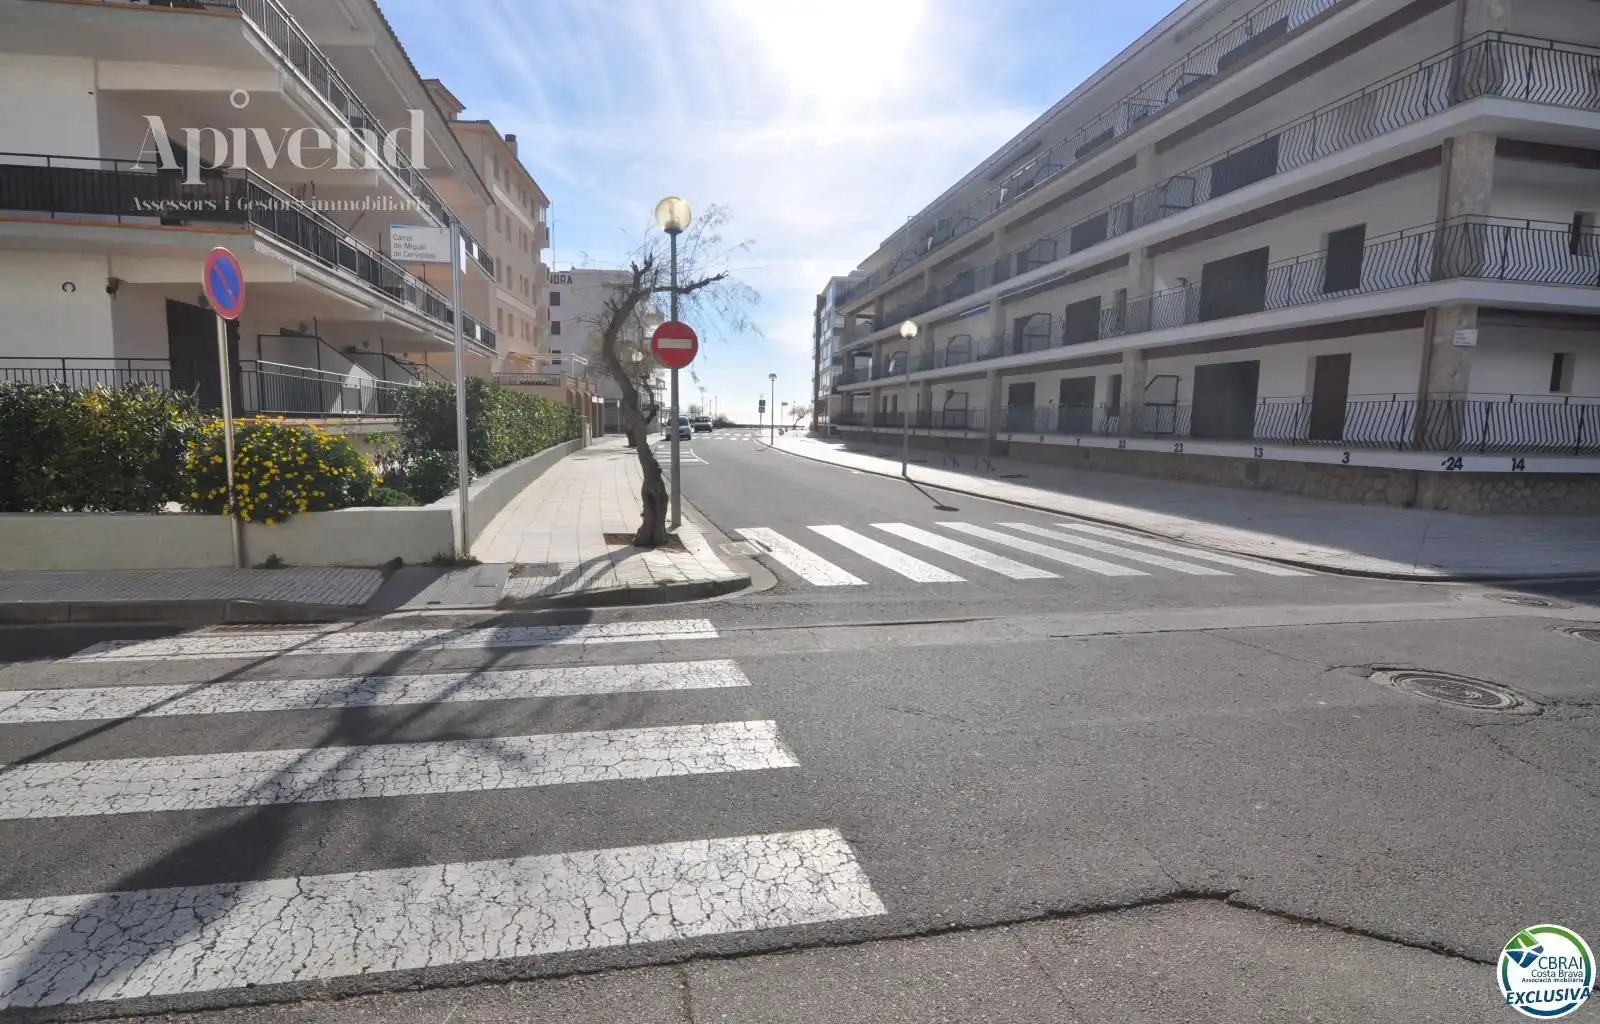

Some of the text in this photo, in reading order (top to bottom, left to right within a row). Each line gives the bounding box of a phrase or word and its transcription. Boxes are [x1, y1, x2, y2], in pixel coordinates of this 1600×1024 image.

[1253, 446, 1264, 458] 13
[1342, 451, 1350, 464] 3
[1511, 457, 1526, 471] 14
